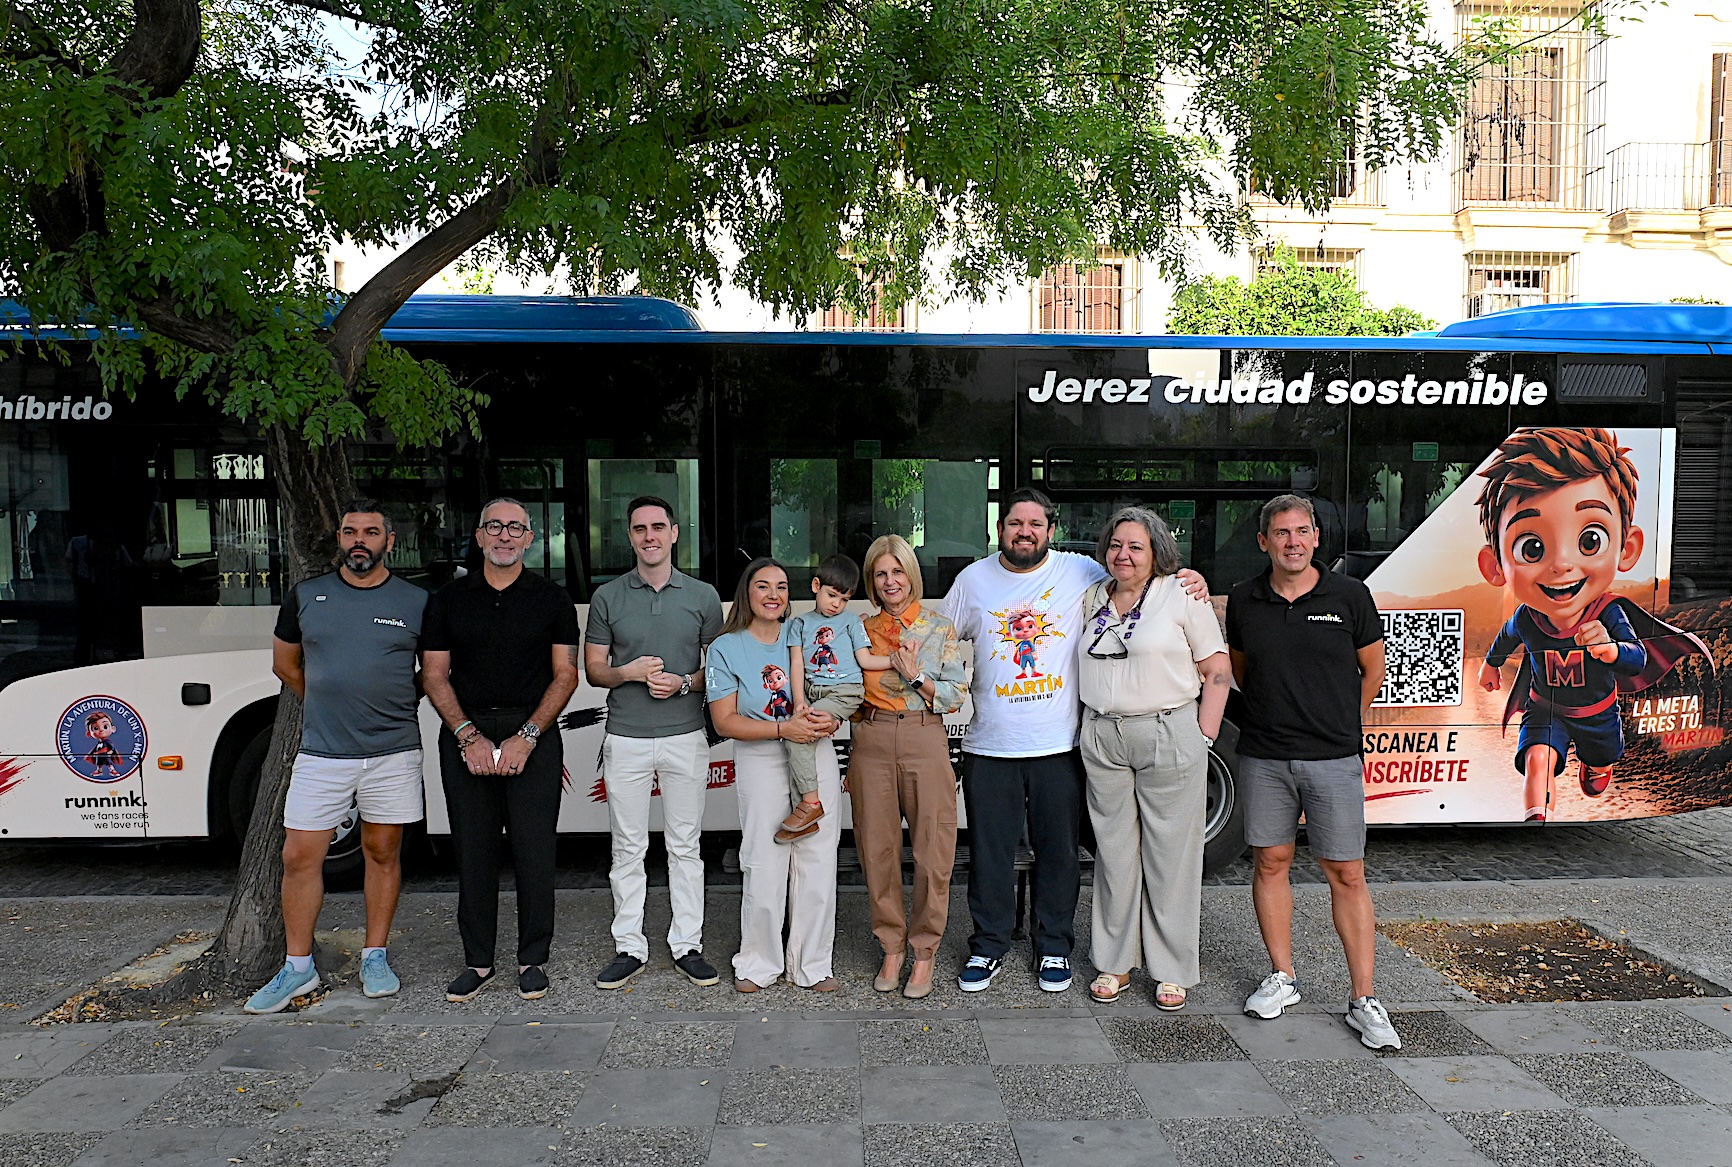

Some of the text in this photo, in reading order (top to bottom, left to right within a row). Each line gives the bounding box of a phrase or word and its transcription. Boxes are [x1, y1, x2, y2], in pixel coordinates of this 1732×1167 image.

[1028, 370, 1549, 406] Jerez ciudad sostenible
[0, 395, 113, 420] híbrido
[1545, 650, 1585, 687] M
[995, 674, 1063, 698] MARTÍN
[63, 716, 76, 728] LA
[72, 700, 116, 718] AVENTURA
[117, 707, 131, 718] DE
[127, 716, 140, 731] UN
[1632, 694, 1699, 718] LA META
[1637, 716, 1677, 735] ERES
[1361, 731, 1459, 753] SCANEA E
[1363, 755, 1470, 784] NSCRÍBETE
[81, 811, 149, 821] we fans races
[110, 820, 131, 829] love
